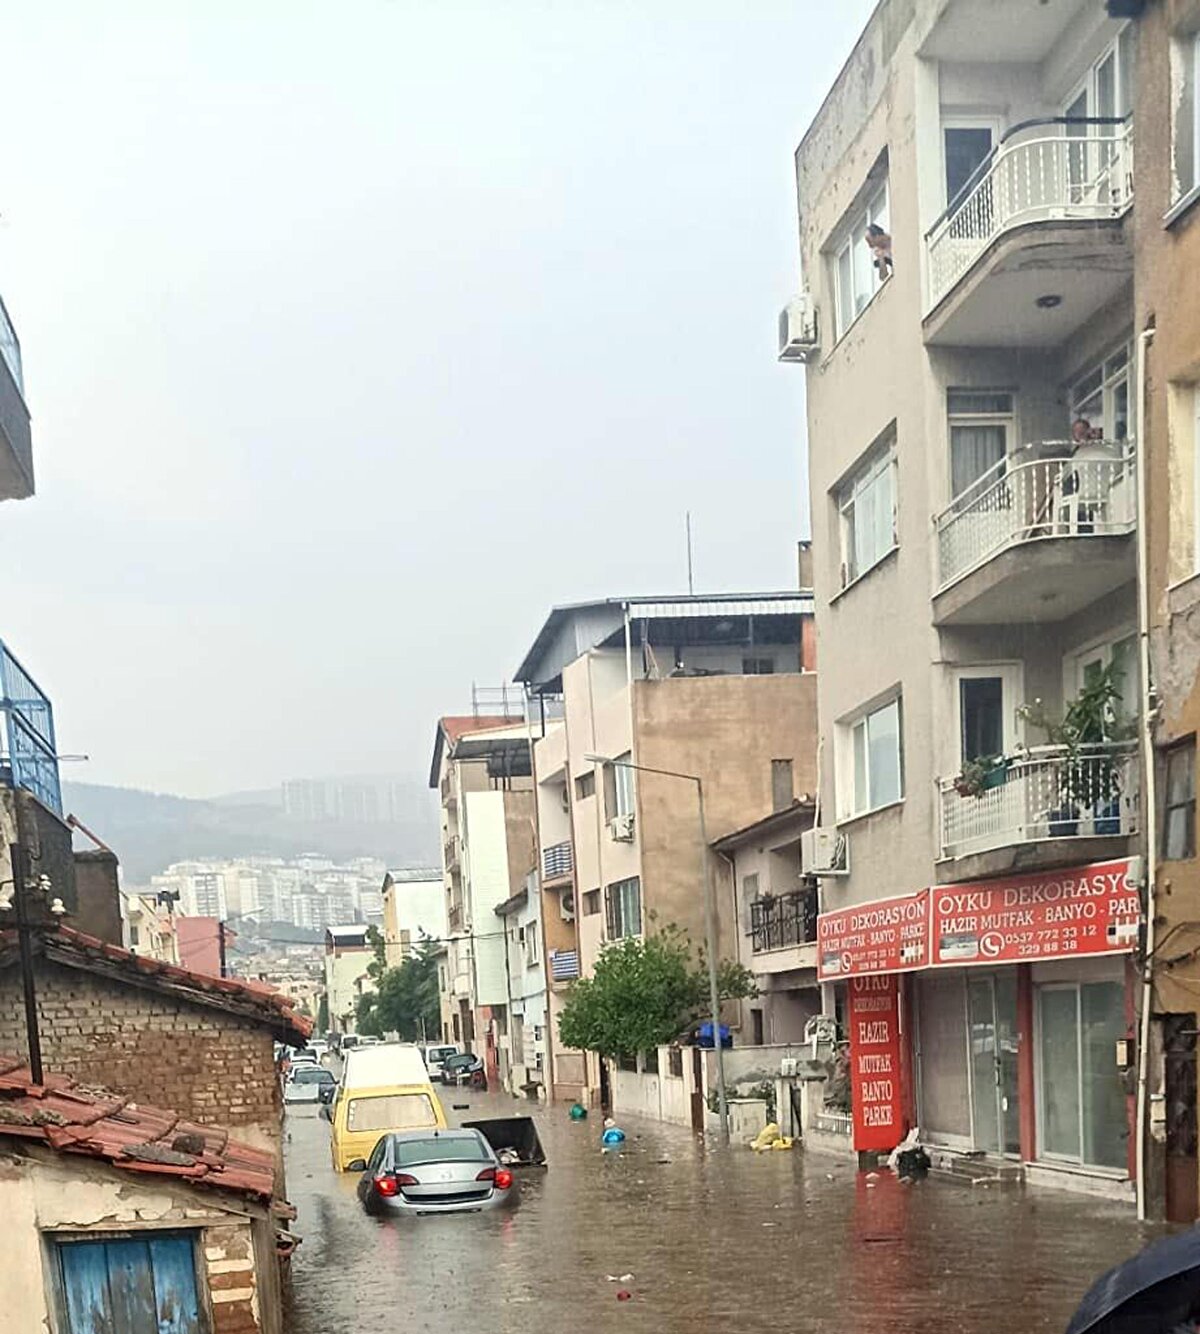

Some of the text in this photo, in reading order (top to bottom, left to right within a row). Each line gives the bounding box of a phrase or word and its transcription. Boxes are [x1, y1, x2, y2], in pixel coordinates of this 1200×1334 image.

[1004, 873, 1139, 907] DEKORASYO
[851, 900, 926, 931] DEKORASYON
[940, 916, 978, 934] HAZIR
[981, 909, 1035, 930] MUTFAK
[1045, 902, 1096, 923] BANYO
[1108, 896, 1140, 916] PAR
[870, 929, 896, 946] BANYO
[1037, 929, 1060, 940] 772
[1062, 927, 1077, 938] 33
[1081, 925, 1097, 936] 12
[1018, 940, 1078, 955] 329 88 38
[859, 1021, 890, 1044] HAZIR
[859, 1054, 892, 1073] MUTFAK
[861, 1080, 893, 1102] BANYO
[863, 1105, 893, 1127] PARKE
